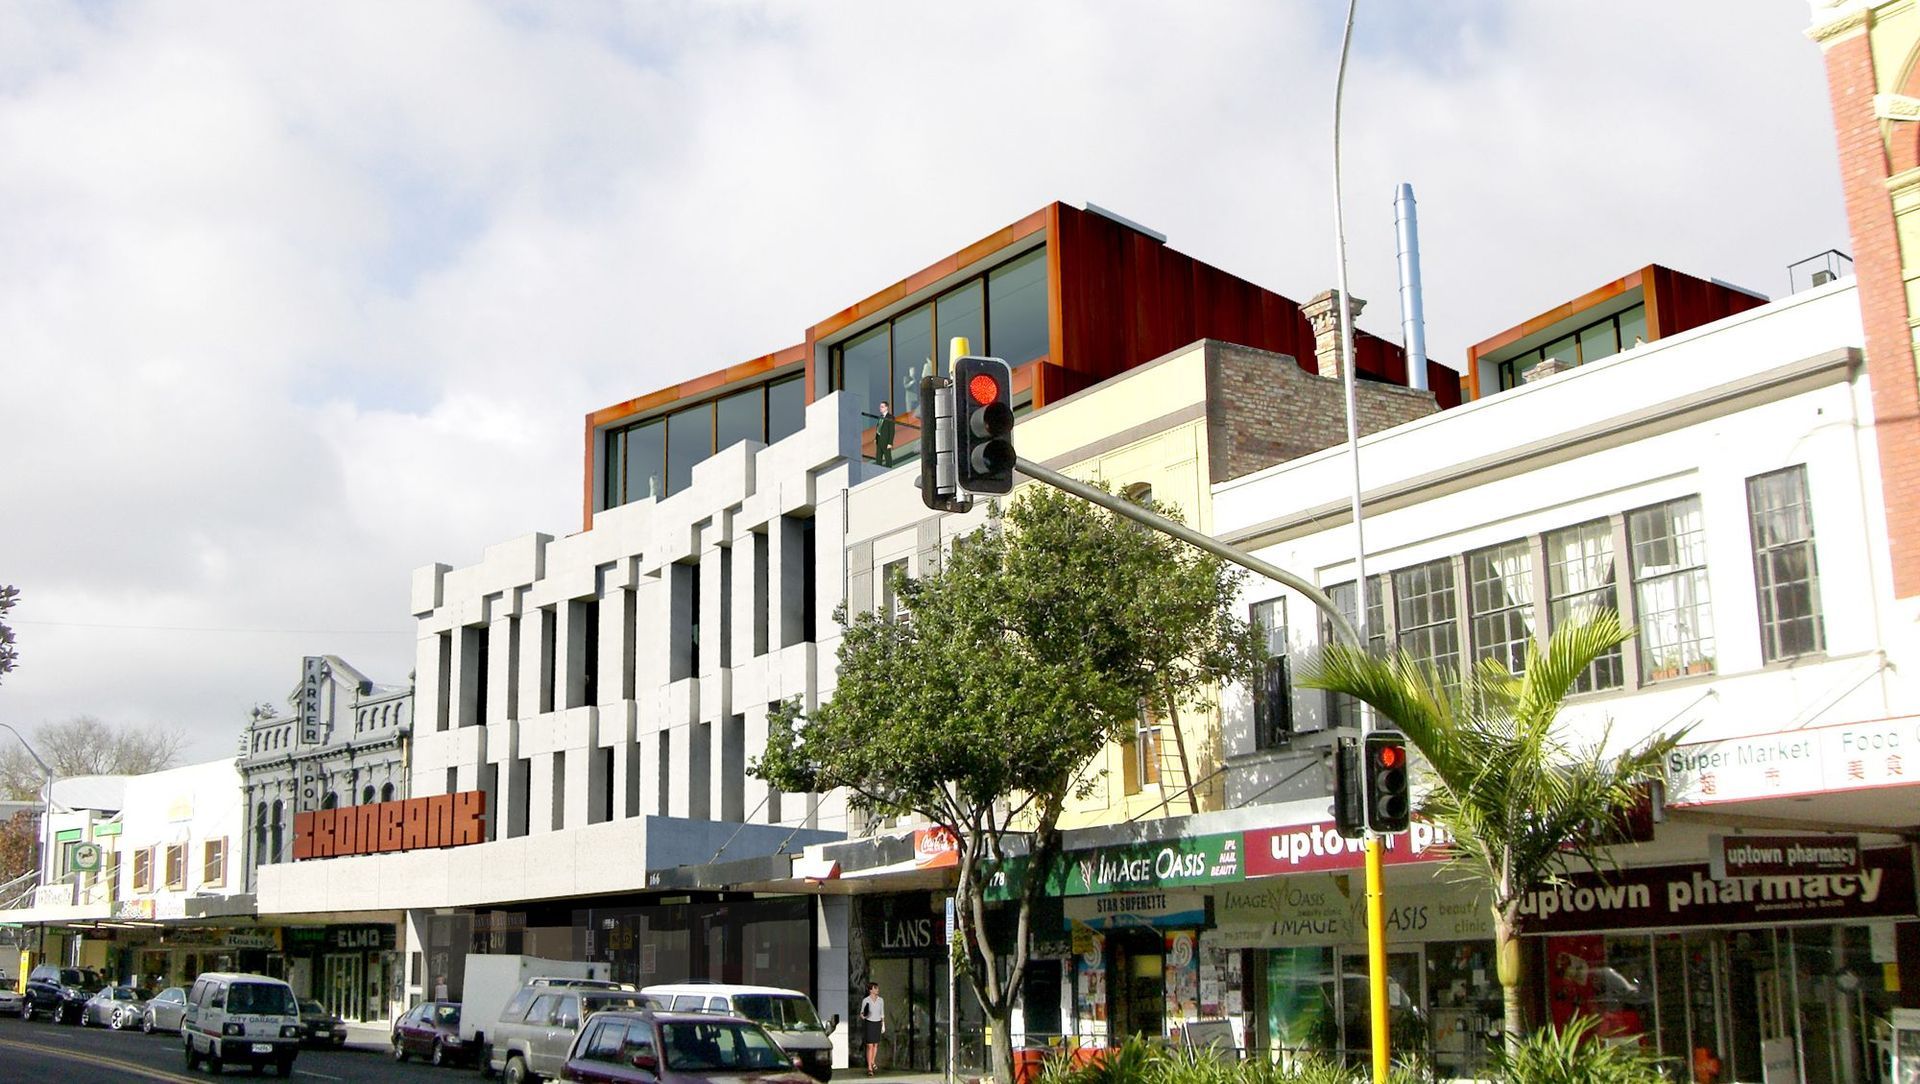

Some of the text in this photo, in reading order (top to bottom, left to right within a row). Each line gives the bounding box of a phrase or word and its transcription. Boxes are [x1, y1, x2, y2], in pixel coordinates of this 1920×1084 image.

[1841, 728, 1899, 753] Food
[1671, 740, 1811, 774] Super Market
[1097, 848, 1207, 884] IMAGE OASIS
[1219, 851, 1237, 863] NAIL
[1727, 843, 1857, 868] uptown pharmacy
[1210, 864, 1237, 877] BEAUTY
[1097, 894, 1167, 913] STAR SUPERETTE
[1224, 889, 1325, 910] IMAGE OASIS
[1519, 868, 1883, 919] uptown pharmacy
[881, 919, 931, 948] LANS
[1455, 919, 1487, 934] clinic
[337, 928, 380, 948] ELMO
[230, 1015, 247, 1023] CITY
